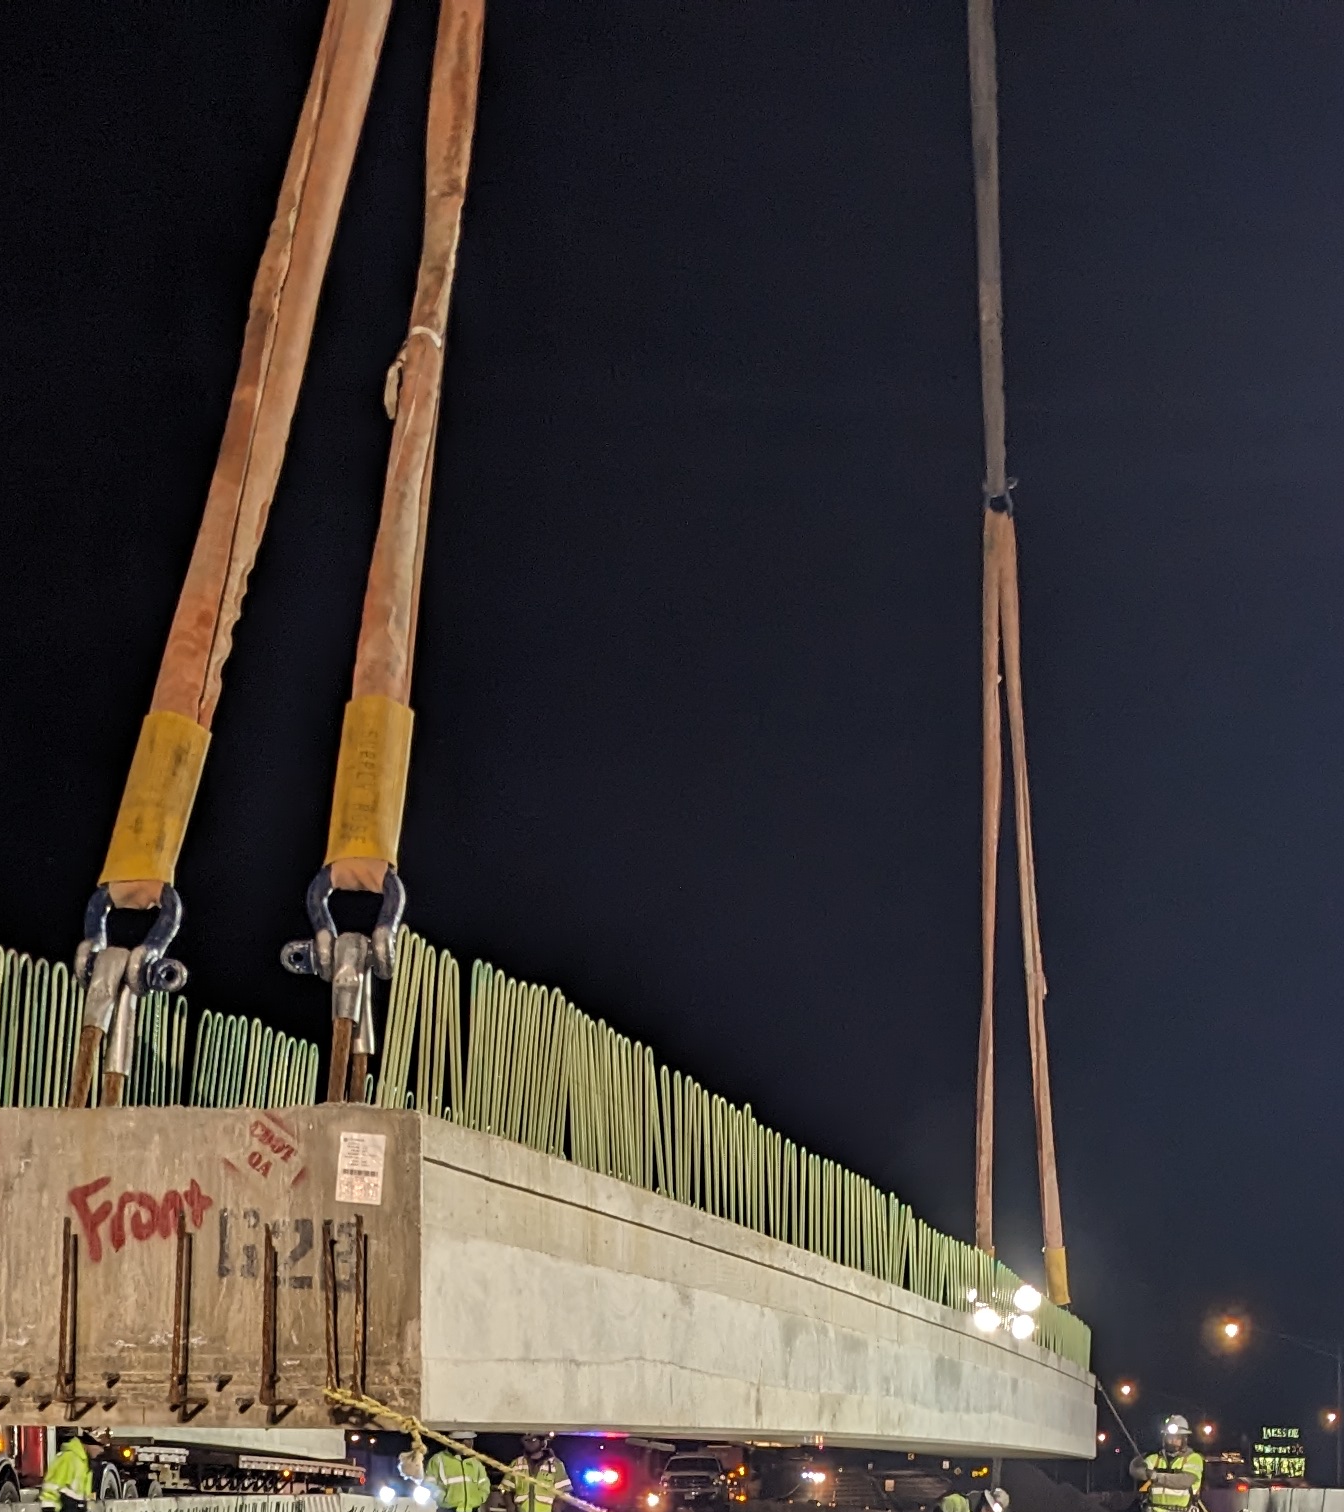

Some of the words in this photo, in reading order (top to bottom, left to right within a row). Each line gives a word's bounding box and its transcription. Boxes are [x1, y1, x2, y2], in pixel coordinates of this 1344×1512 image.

[250, 1119, 296, 1162] CDOT
[247, 1151, 273, 1179] QA
[68, 1176, 214, 1264] Front
